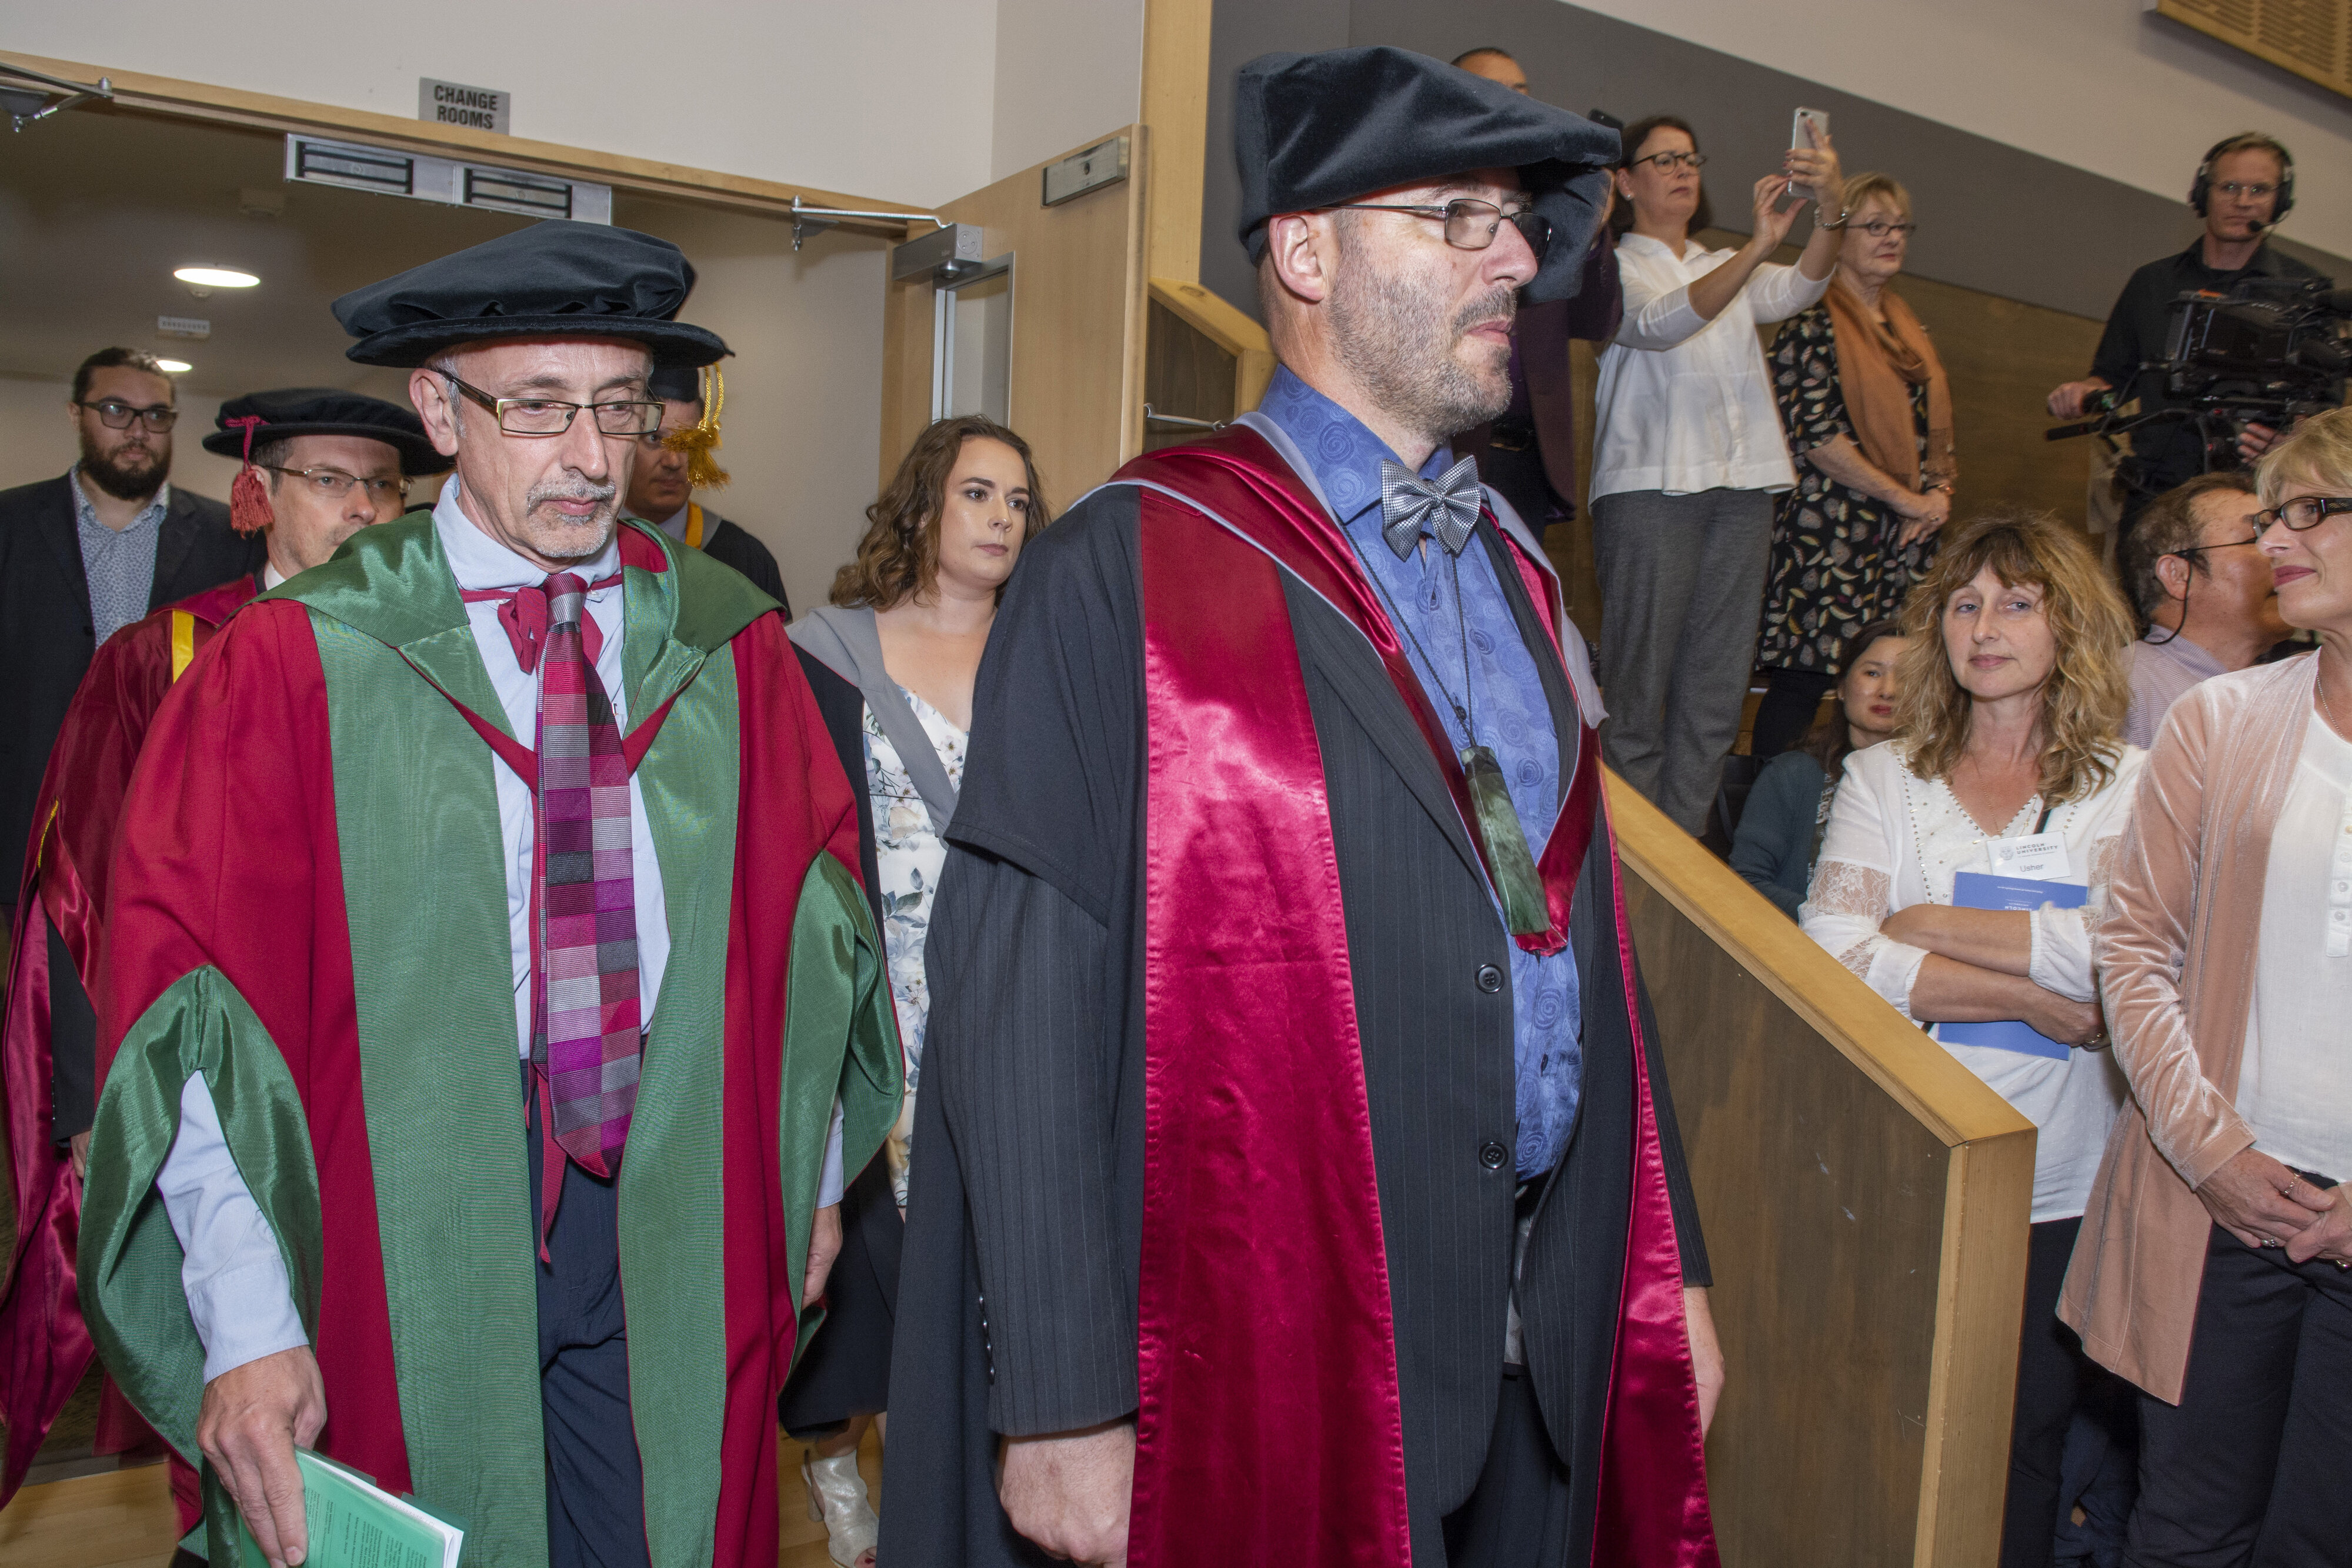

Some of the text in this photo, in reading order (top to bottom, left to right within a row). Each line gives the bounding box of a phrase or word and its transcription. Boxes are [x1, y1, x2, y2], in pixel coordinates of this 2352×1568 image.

[434, 85, 498, 111] CHANGE
[436, 105, 493, 129] ROOMS
[2017, 846, 2057, 854] UNIVERSITY
